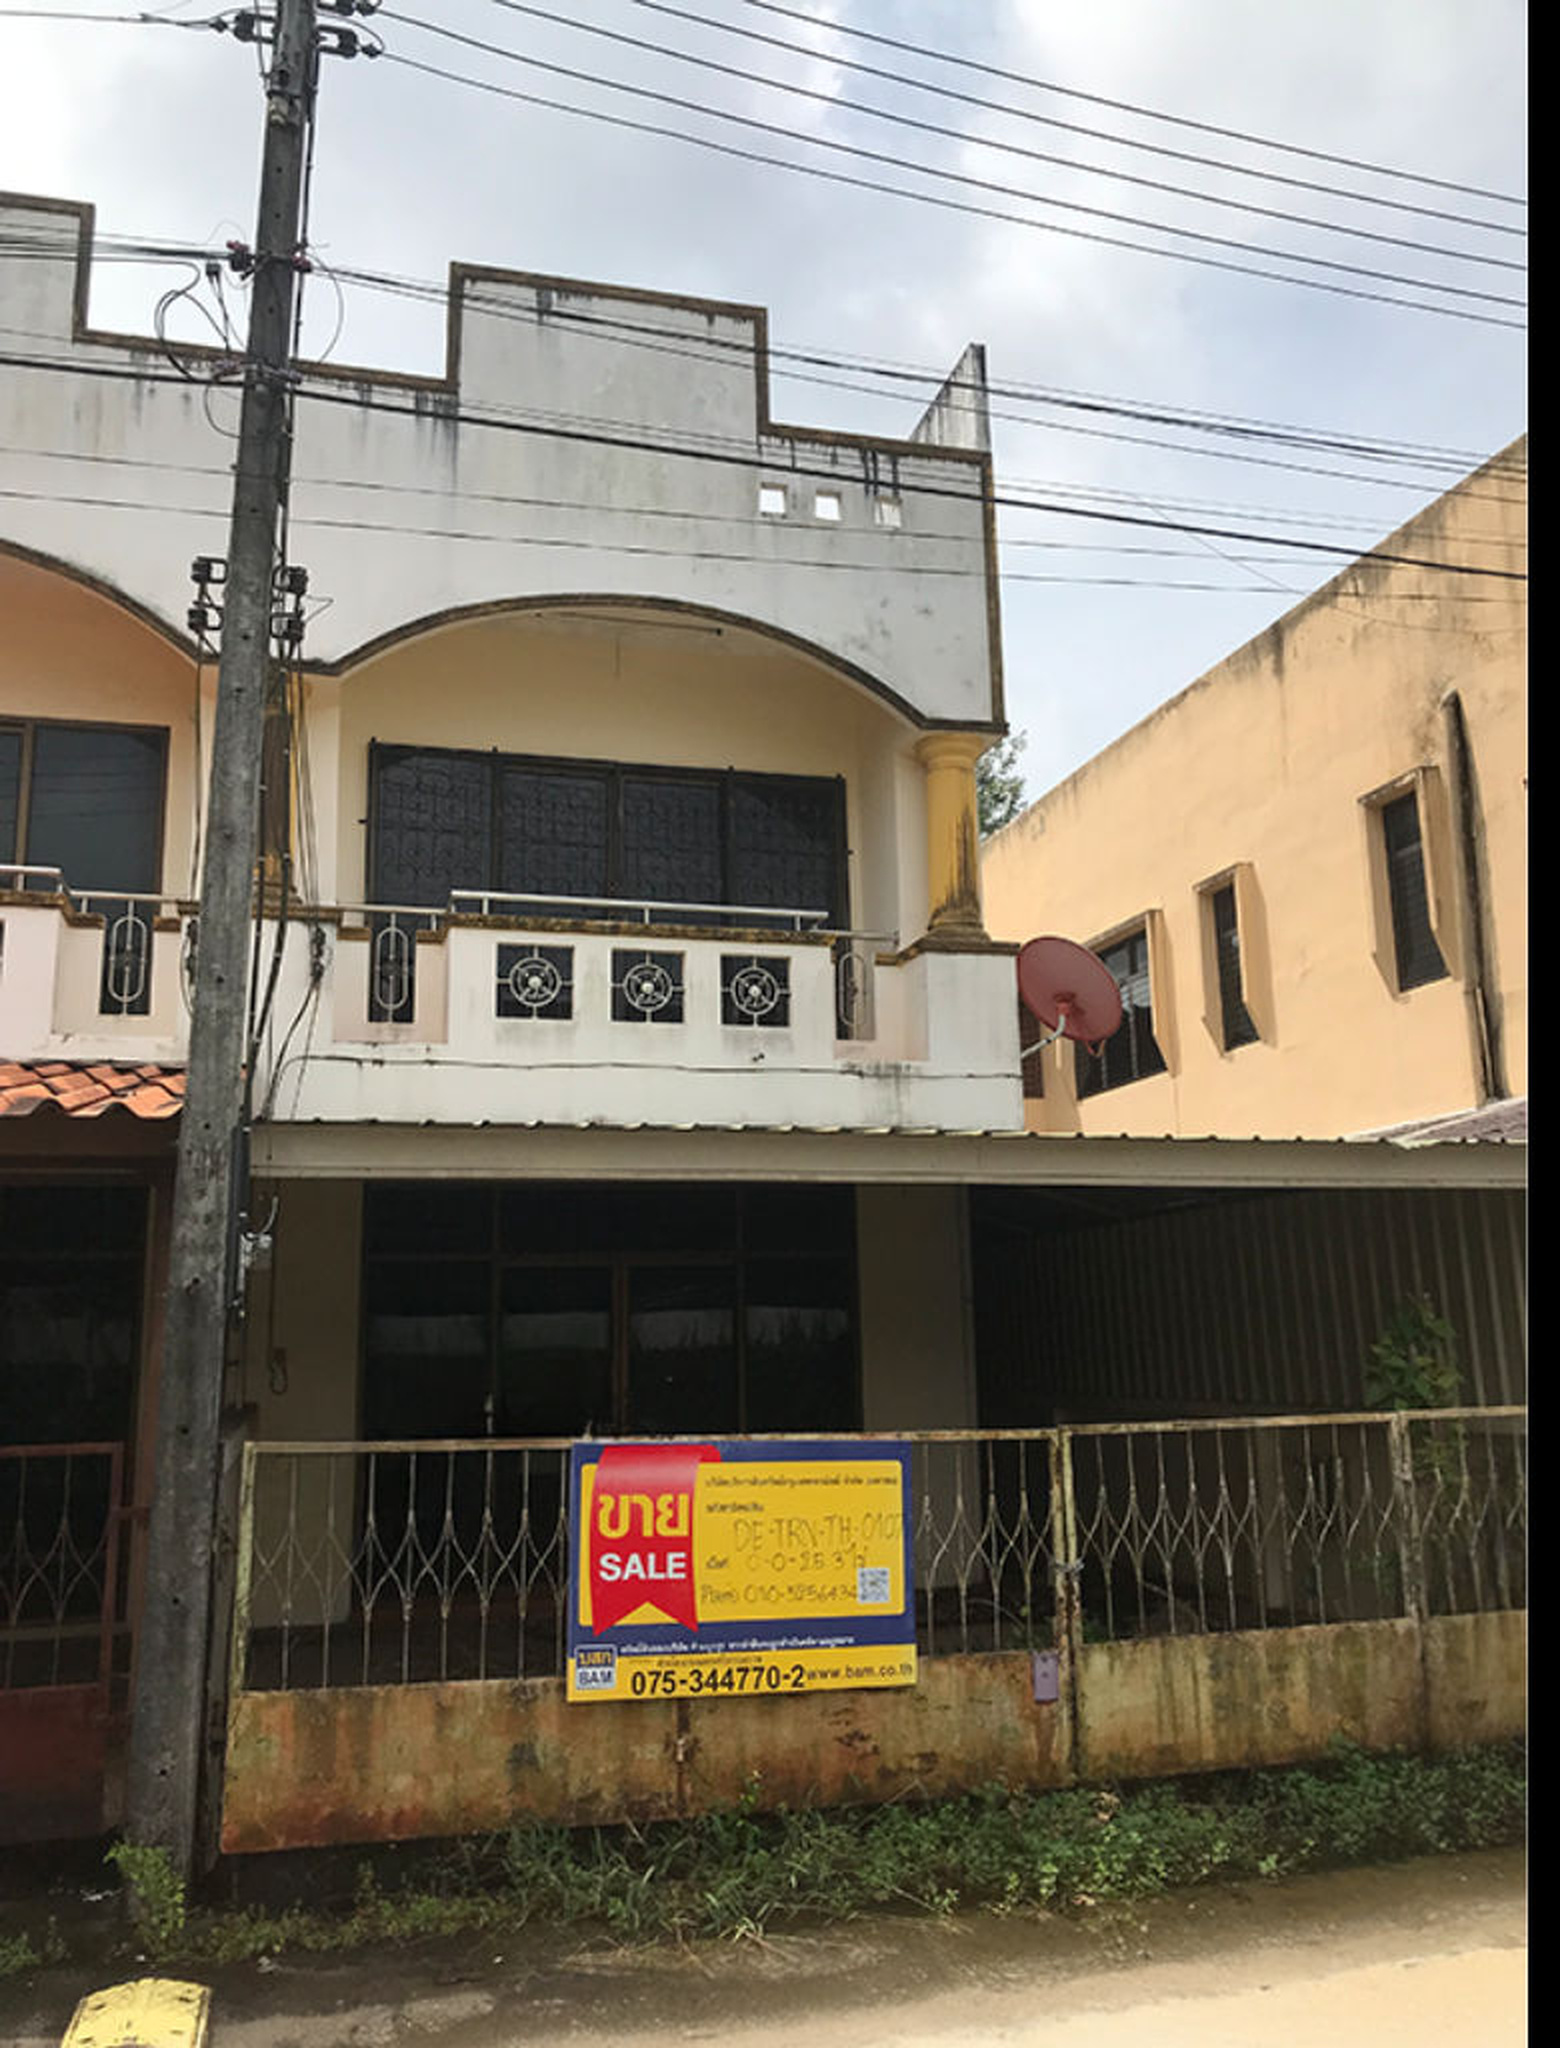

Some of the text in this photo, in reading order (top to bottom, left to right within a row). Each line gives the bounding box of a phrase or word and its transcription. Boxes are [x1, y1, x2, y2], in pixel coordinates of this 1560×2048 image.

[598, 1493, 689, 1538] ขาย
[599, 1552, 686, 1581] SALE
[579, 1670, 612, 1686] BAM
[632, 1663, 913, 1695] 075-344770-2 www.bam.co.th
